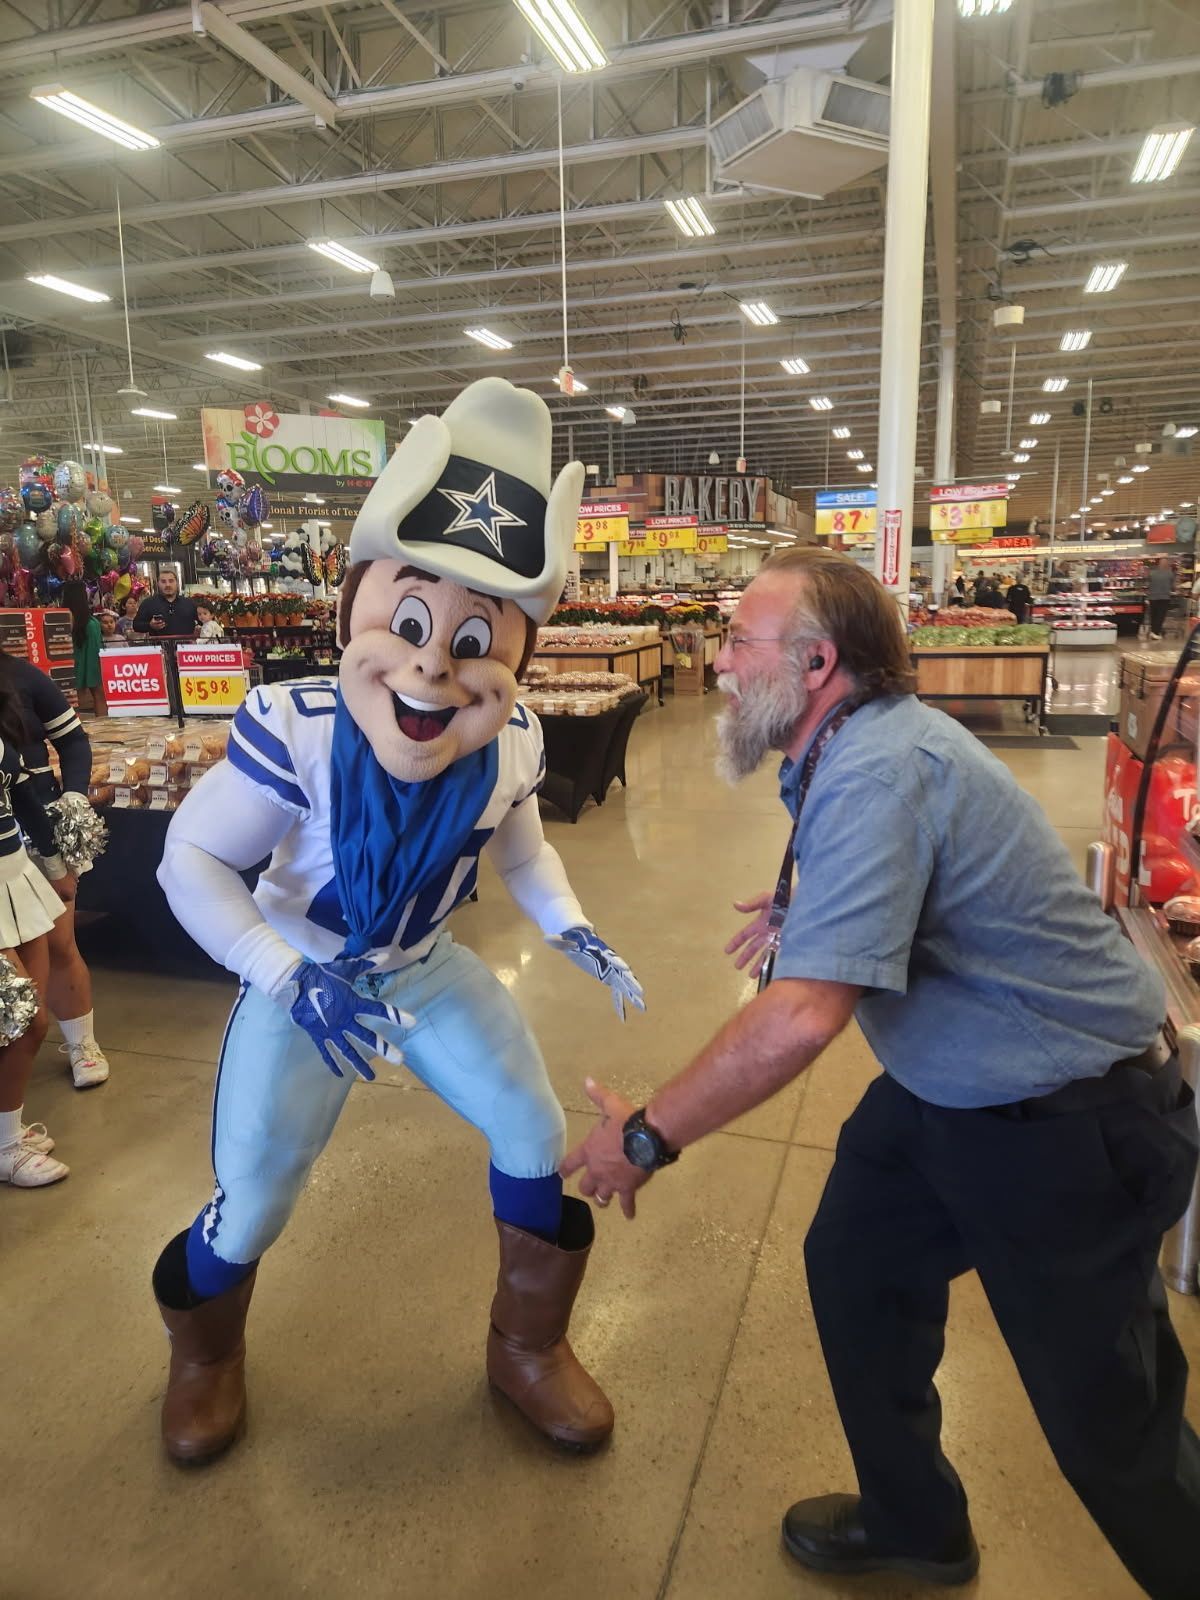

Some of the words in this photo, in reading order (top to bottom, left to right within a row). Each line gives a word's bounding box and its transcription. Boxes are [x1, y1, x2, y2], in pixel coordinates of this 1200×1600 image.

[336, 480, 345, 488] by
[939, 487, 962, 496] LOW
[664, 476, 760, 522] BAKERY
[268, 506, 295, 515] ional
[298, 506, 329, 516] Florist
[331, 507, 341, 516] of
[342, 508, 359, 517] Tex
[578, 505, 593, 513] OW
[593, 504, 622, 513] PRICES
[651, 518, 667, 526] LOW
[667, 516, 692, 525] PRICES
[183, 654, 203, 663] LOW
[204, 653, 236, 663] PRICES
[113, 663, 149, 678] LOW
[107, 678, 160, 693] PRICES
